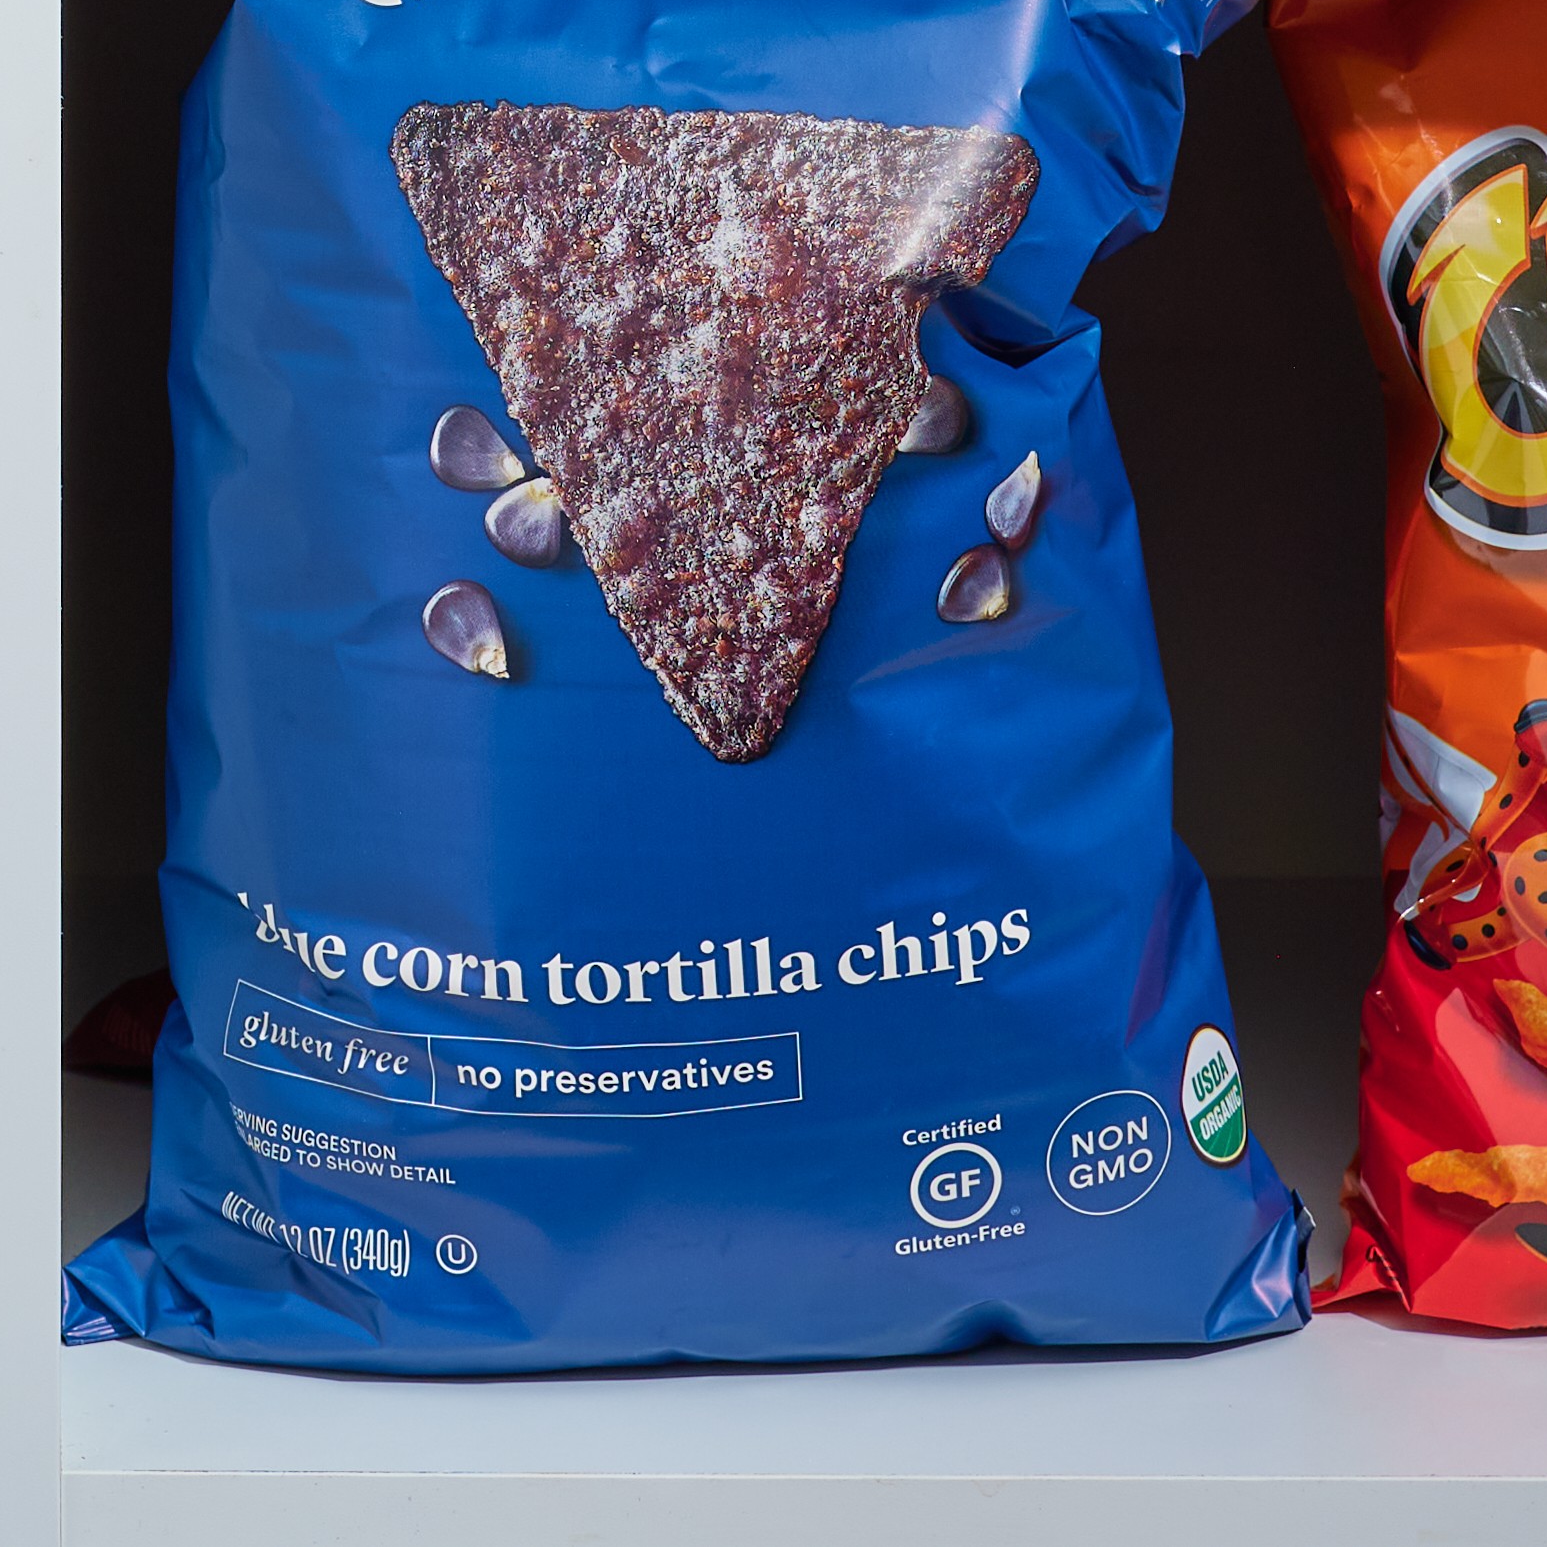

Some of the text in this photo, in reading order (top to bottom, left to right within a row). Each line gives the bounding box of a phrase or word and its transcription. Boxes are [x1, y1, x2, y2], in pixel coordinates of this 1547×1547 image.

[456, 1054, 775, 1095] no preservatives
[1069, 1116, 1150, 1159] NON
[1068, 1150, 1155, 1190] GMO
